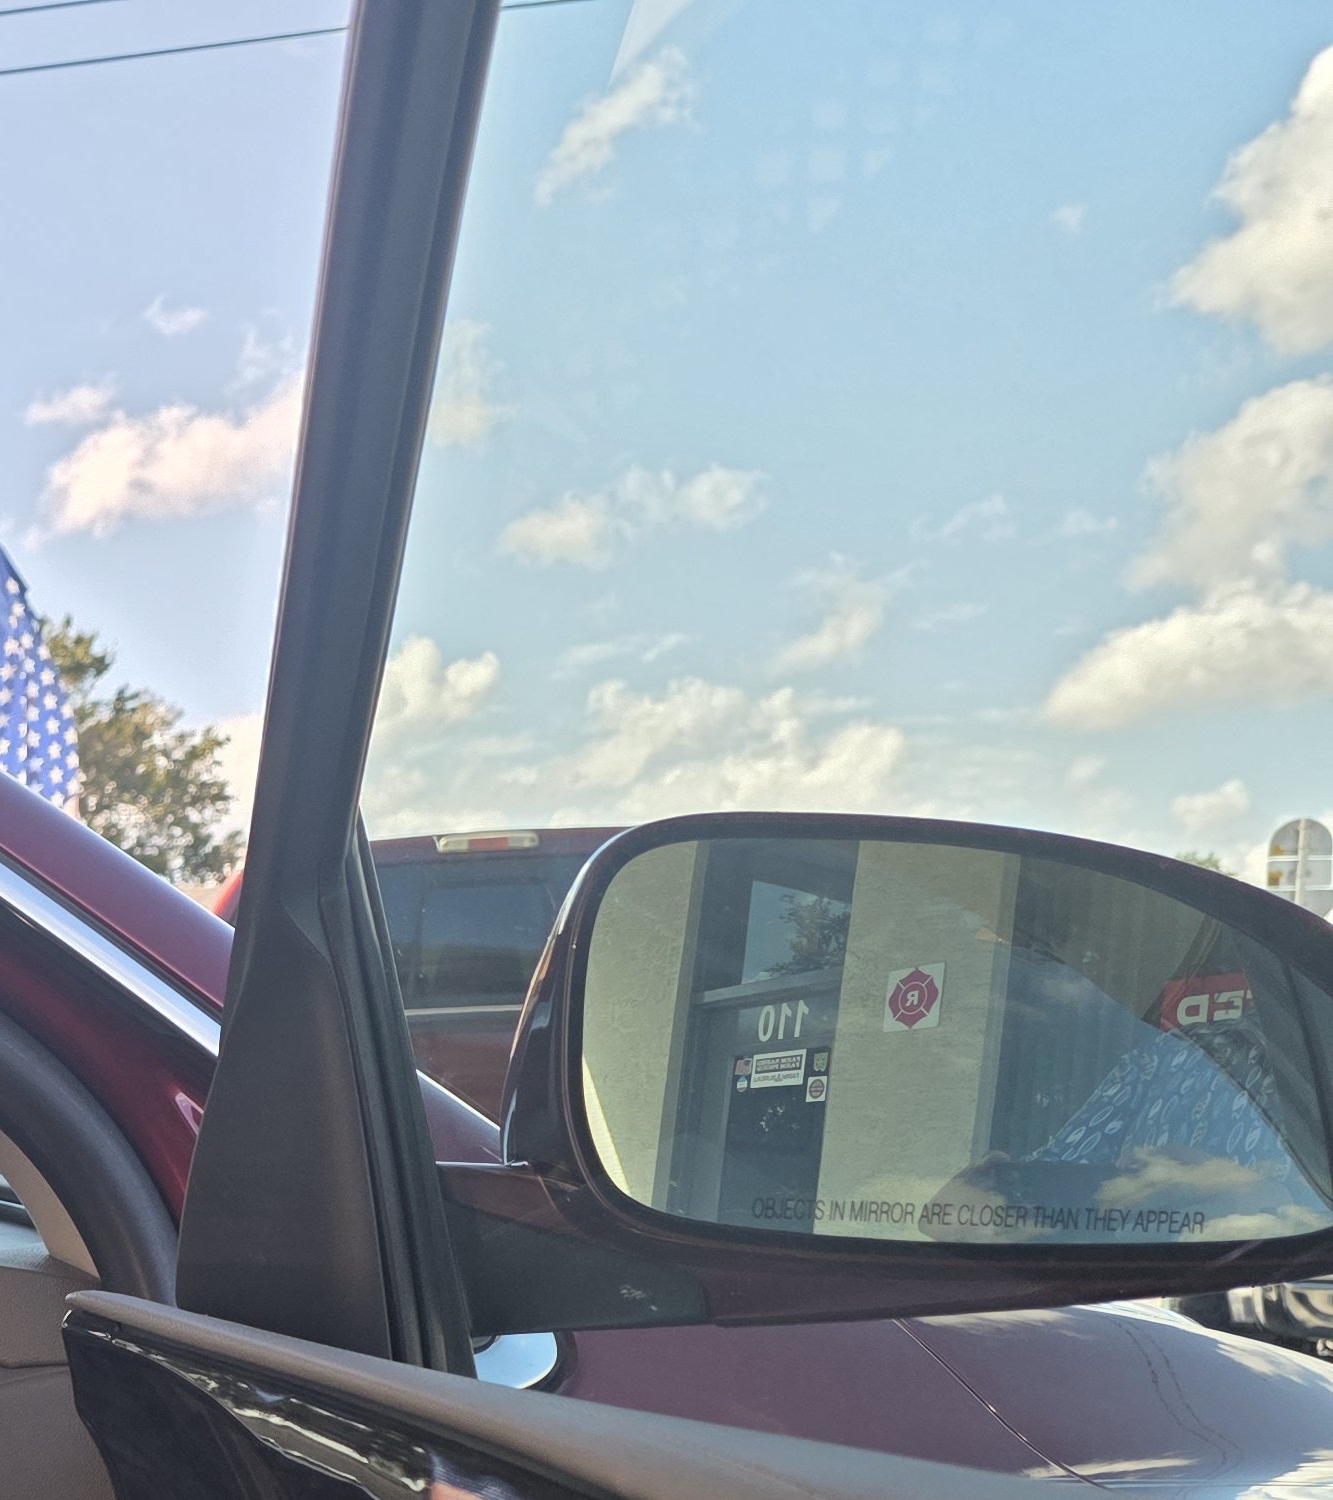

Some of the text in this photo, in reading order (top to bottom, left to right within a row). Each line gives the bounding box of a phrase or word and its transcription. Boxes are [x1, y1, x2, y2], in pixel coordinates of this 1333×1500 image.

[751, 1196, 1206, 1234] OBJECTS IN MIRROR ARE CLOSER THAN THEY APPEAR
